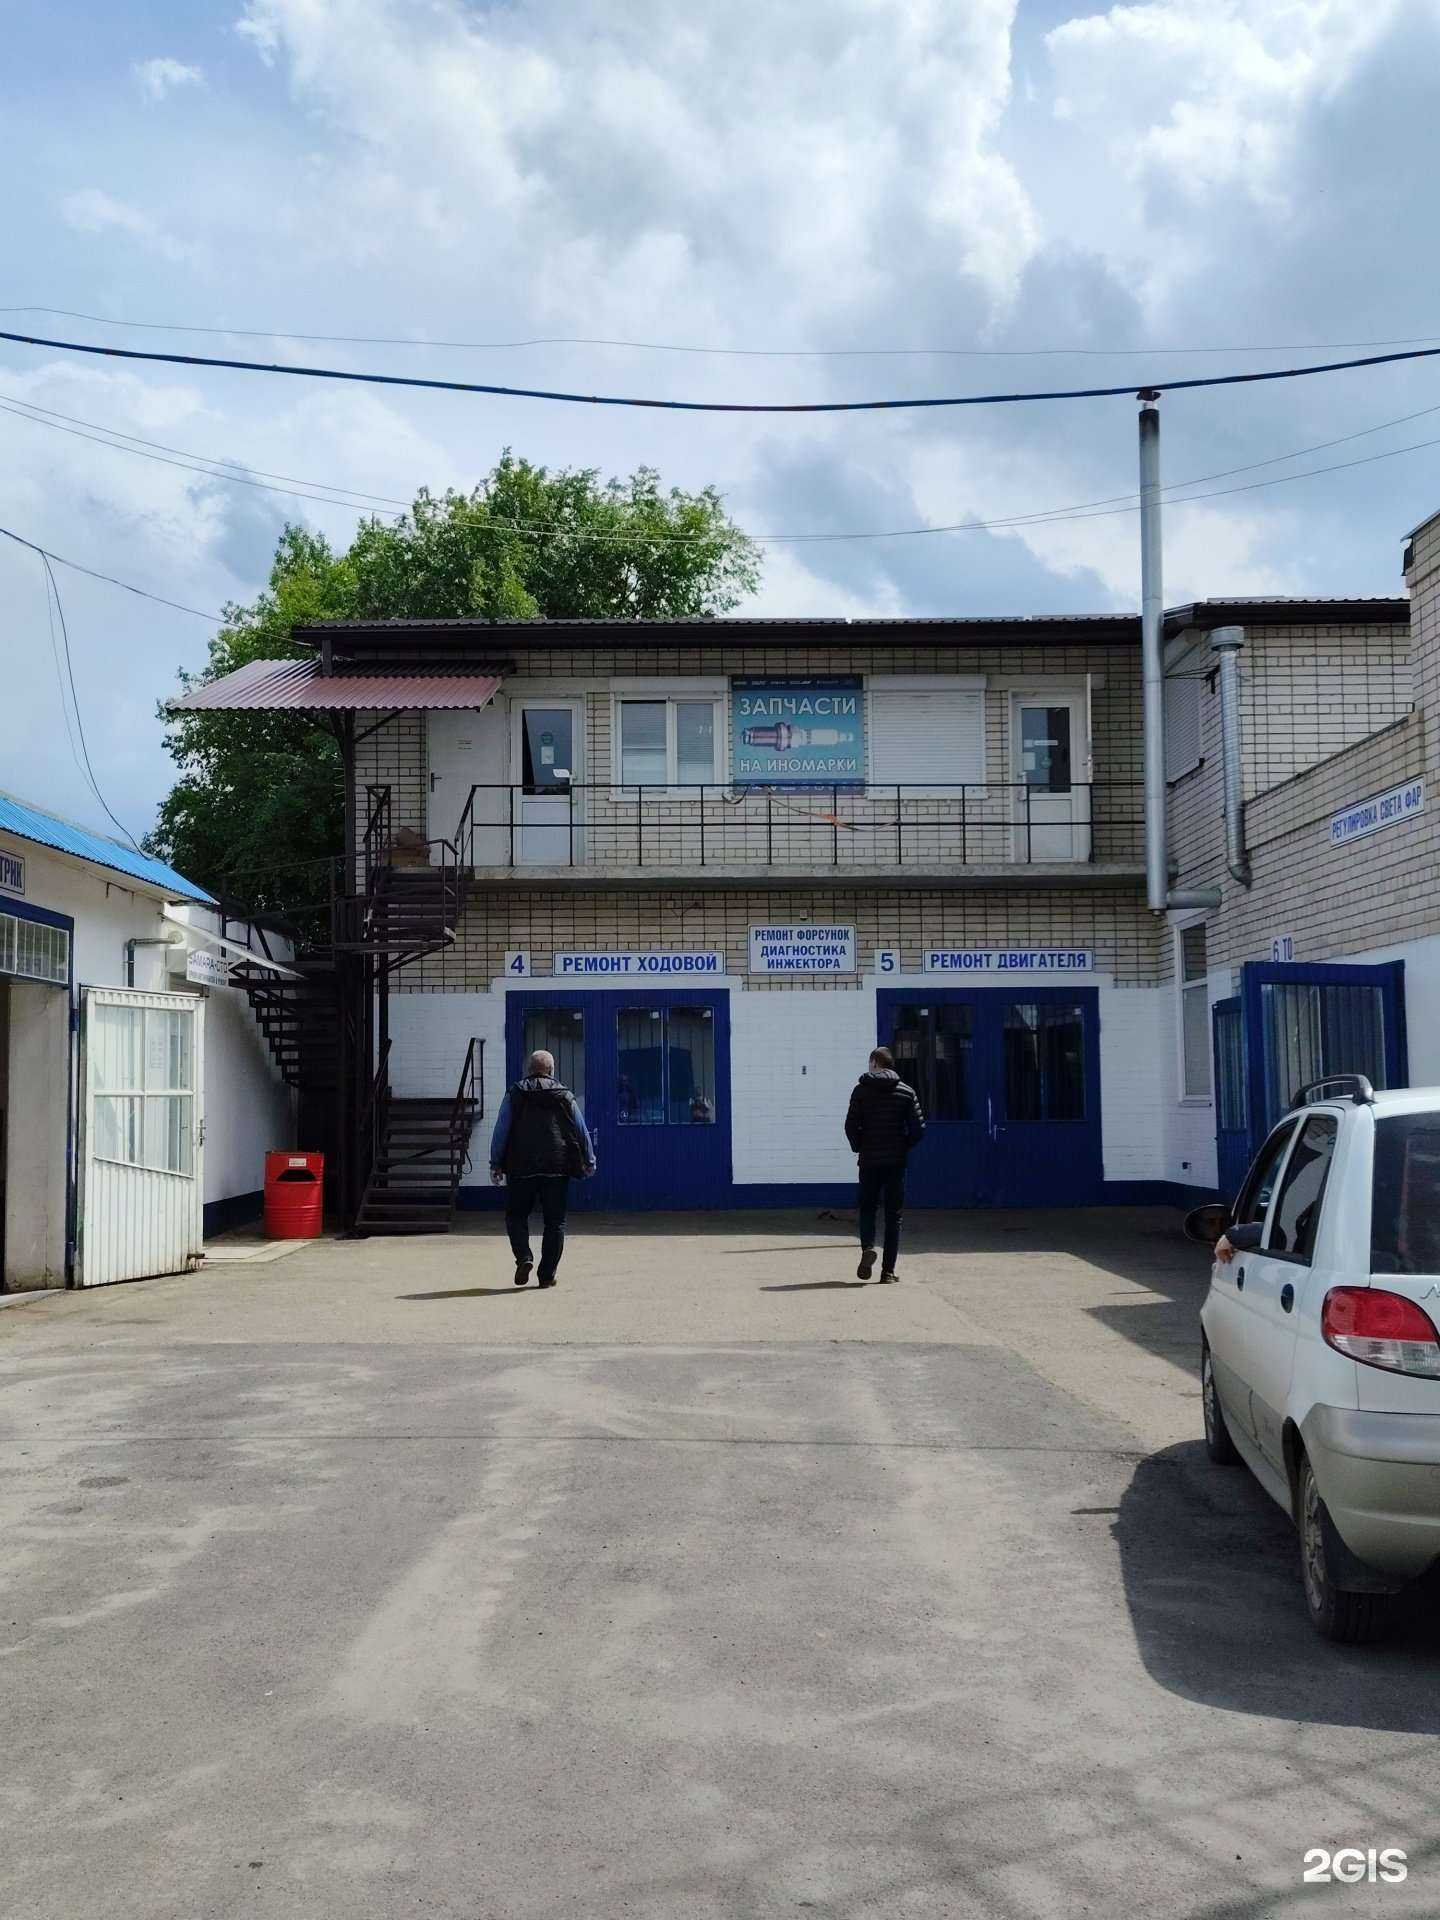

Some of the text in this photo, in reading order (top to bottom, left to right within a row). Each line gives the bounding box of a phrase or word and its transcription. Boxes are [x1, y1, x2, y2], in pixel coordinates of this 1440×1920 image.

[739, 697, 857, 716] ЗАПЧАСТИ
[739, 758, 857, 773] НА ИНОМАРКИ
[1331, 785, 1422, 842] РЕГУЛИРОВКА СВЕТА ФАР
[754, 928, 851, 942] РЕМОНТ ФОРСУНОК
[760, 944, 847, 958] ДИАГНОСТИКА
[1282, 936, 1293, 961] ТО
[509, 954, 524, 974] 4
[562, 952, 718, 973] РЕМОНТ ХОДОВОЙ
[766, 957, 841, 970] ИНЖЕКТОРА
[880, 952, 894, 972] 5
[930, 953, 1087, 969] РЕМОНТ ДВИГАТЕЛЯ
